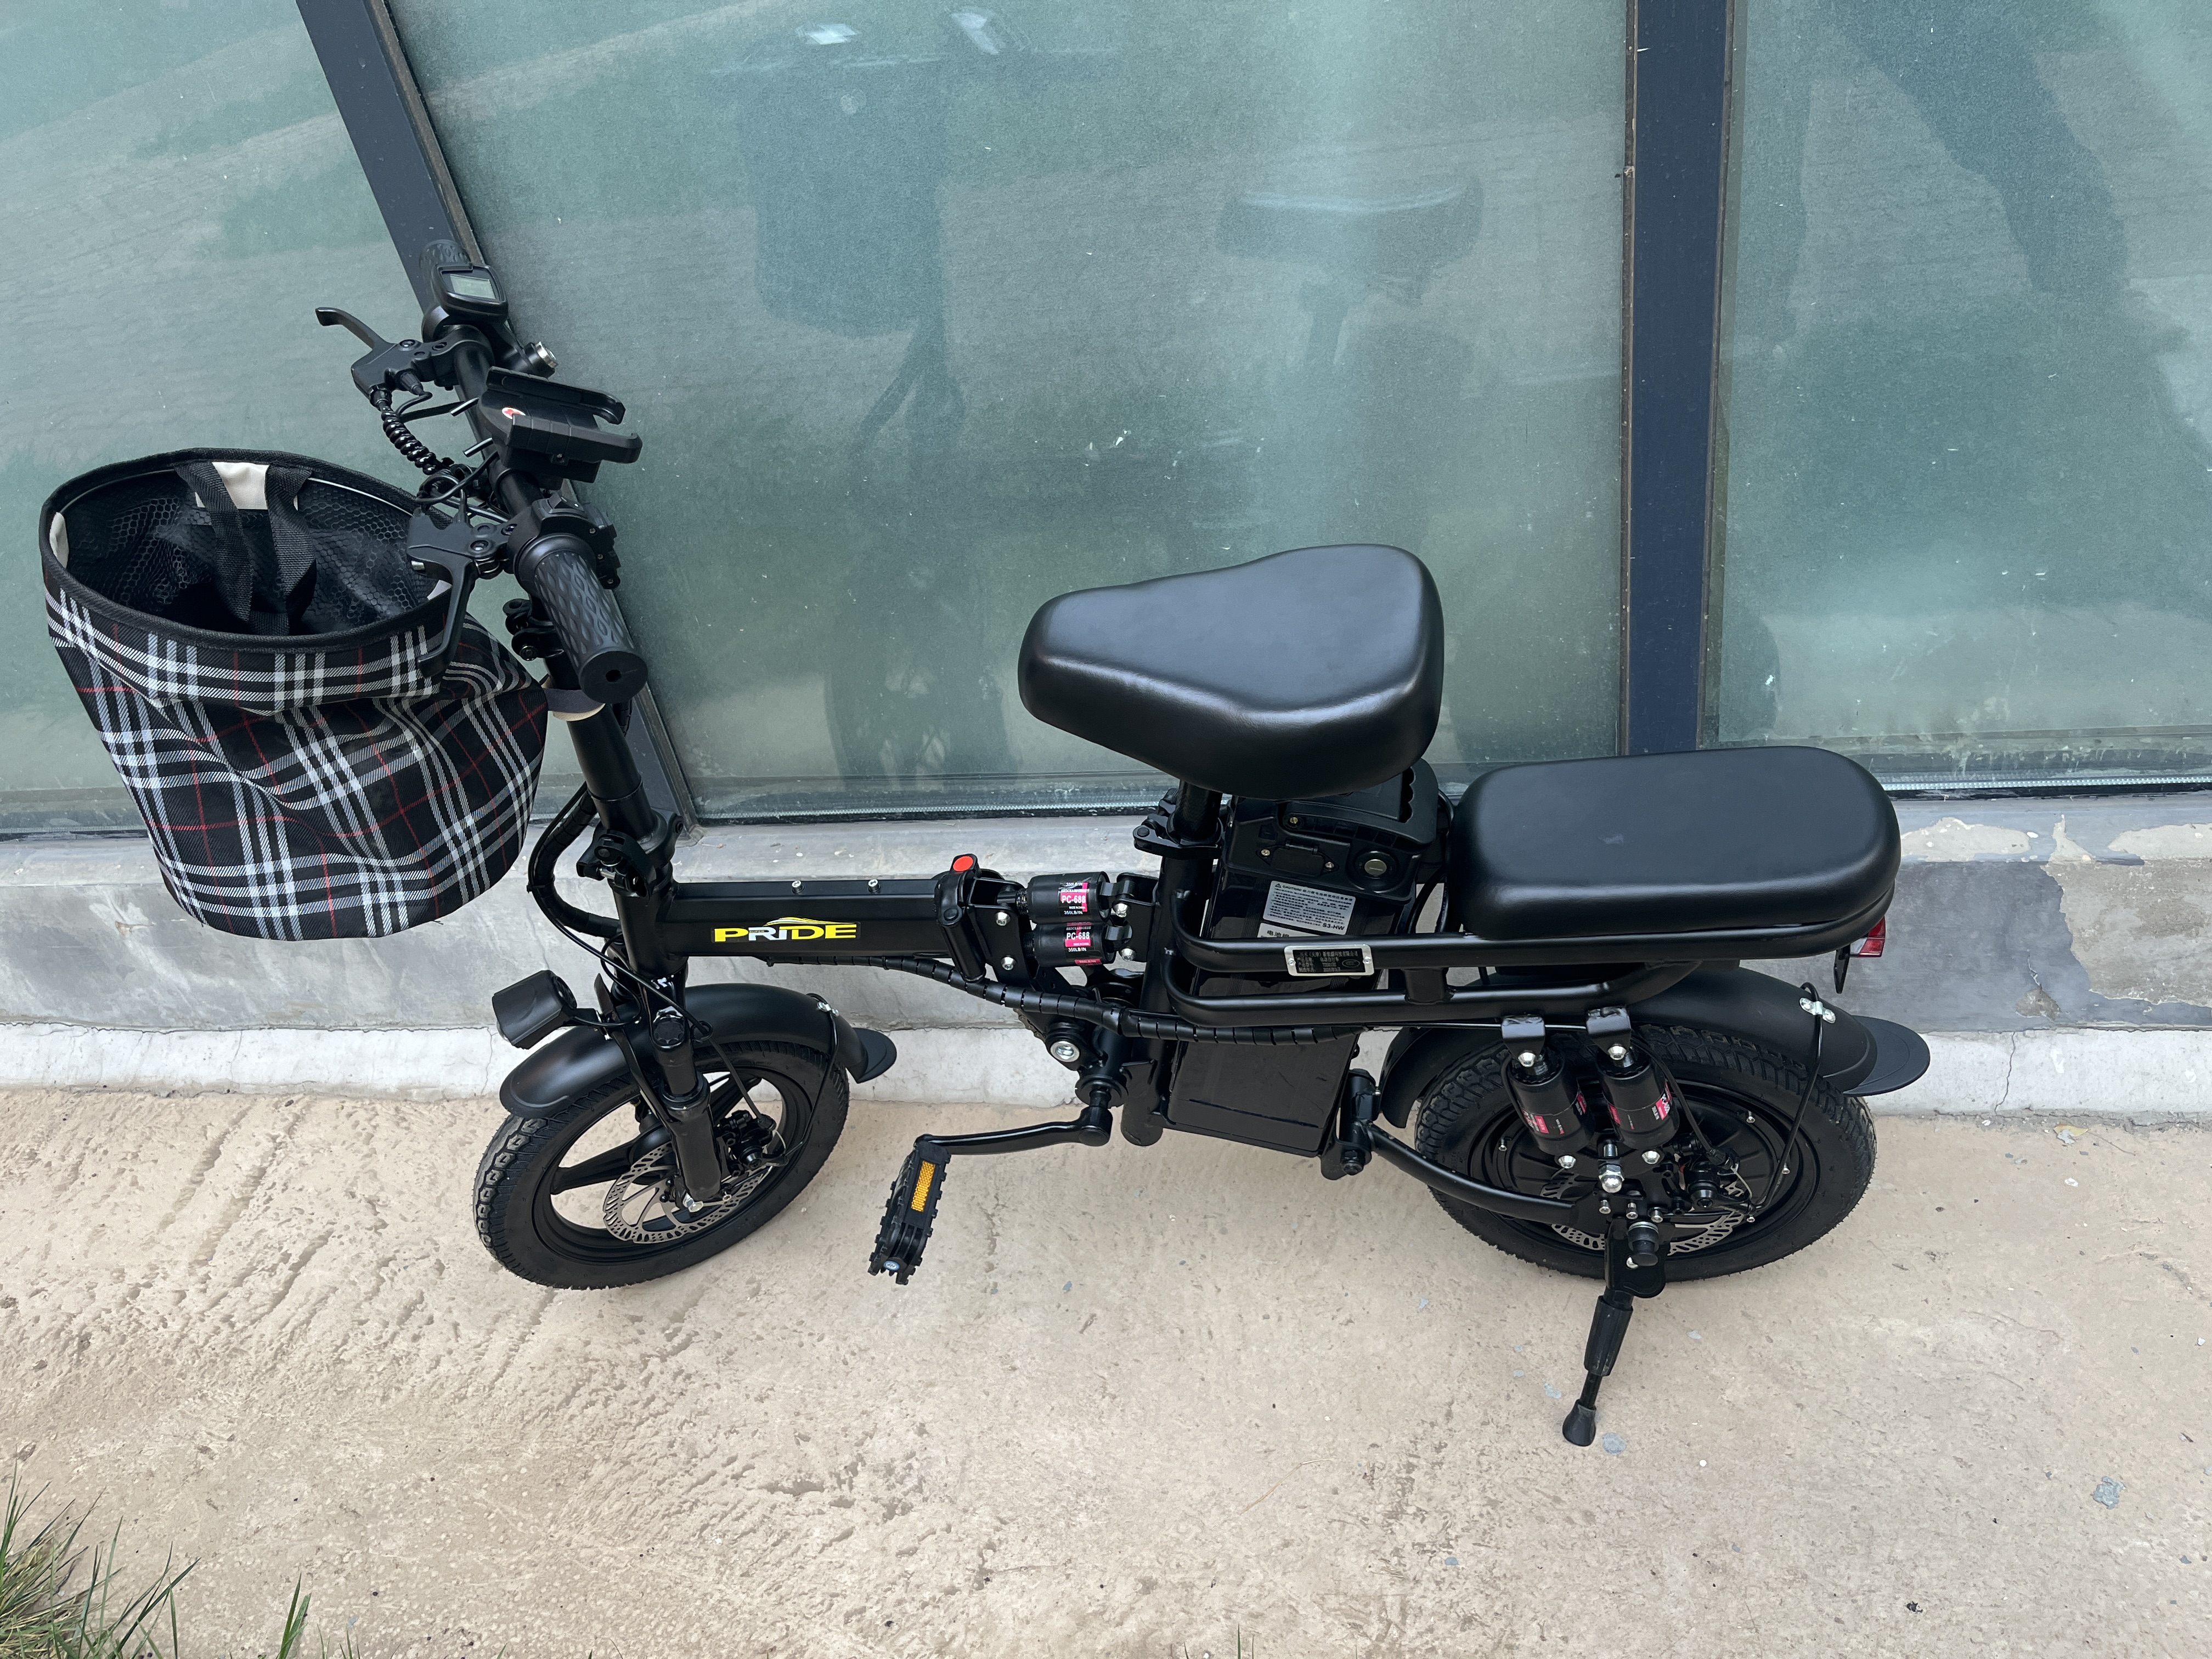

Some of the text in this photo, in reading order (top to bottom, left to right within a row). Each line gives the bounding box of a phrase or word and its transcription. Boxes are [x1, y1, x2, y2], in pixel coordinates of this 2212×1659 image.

[1062, 895, 1086, 904] PC-688
[1322, 922, 1345, 930] S3-HW
[714, 924, 857, 942] PRIDE
[1066, 932, 1090, 940] PC-688
